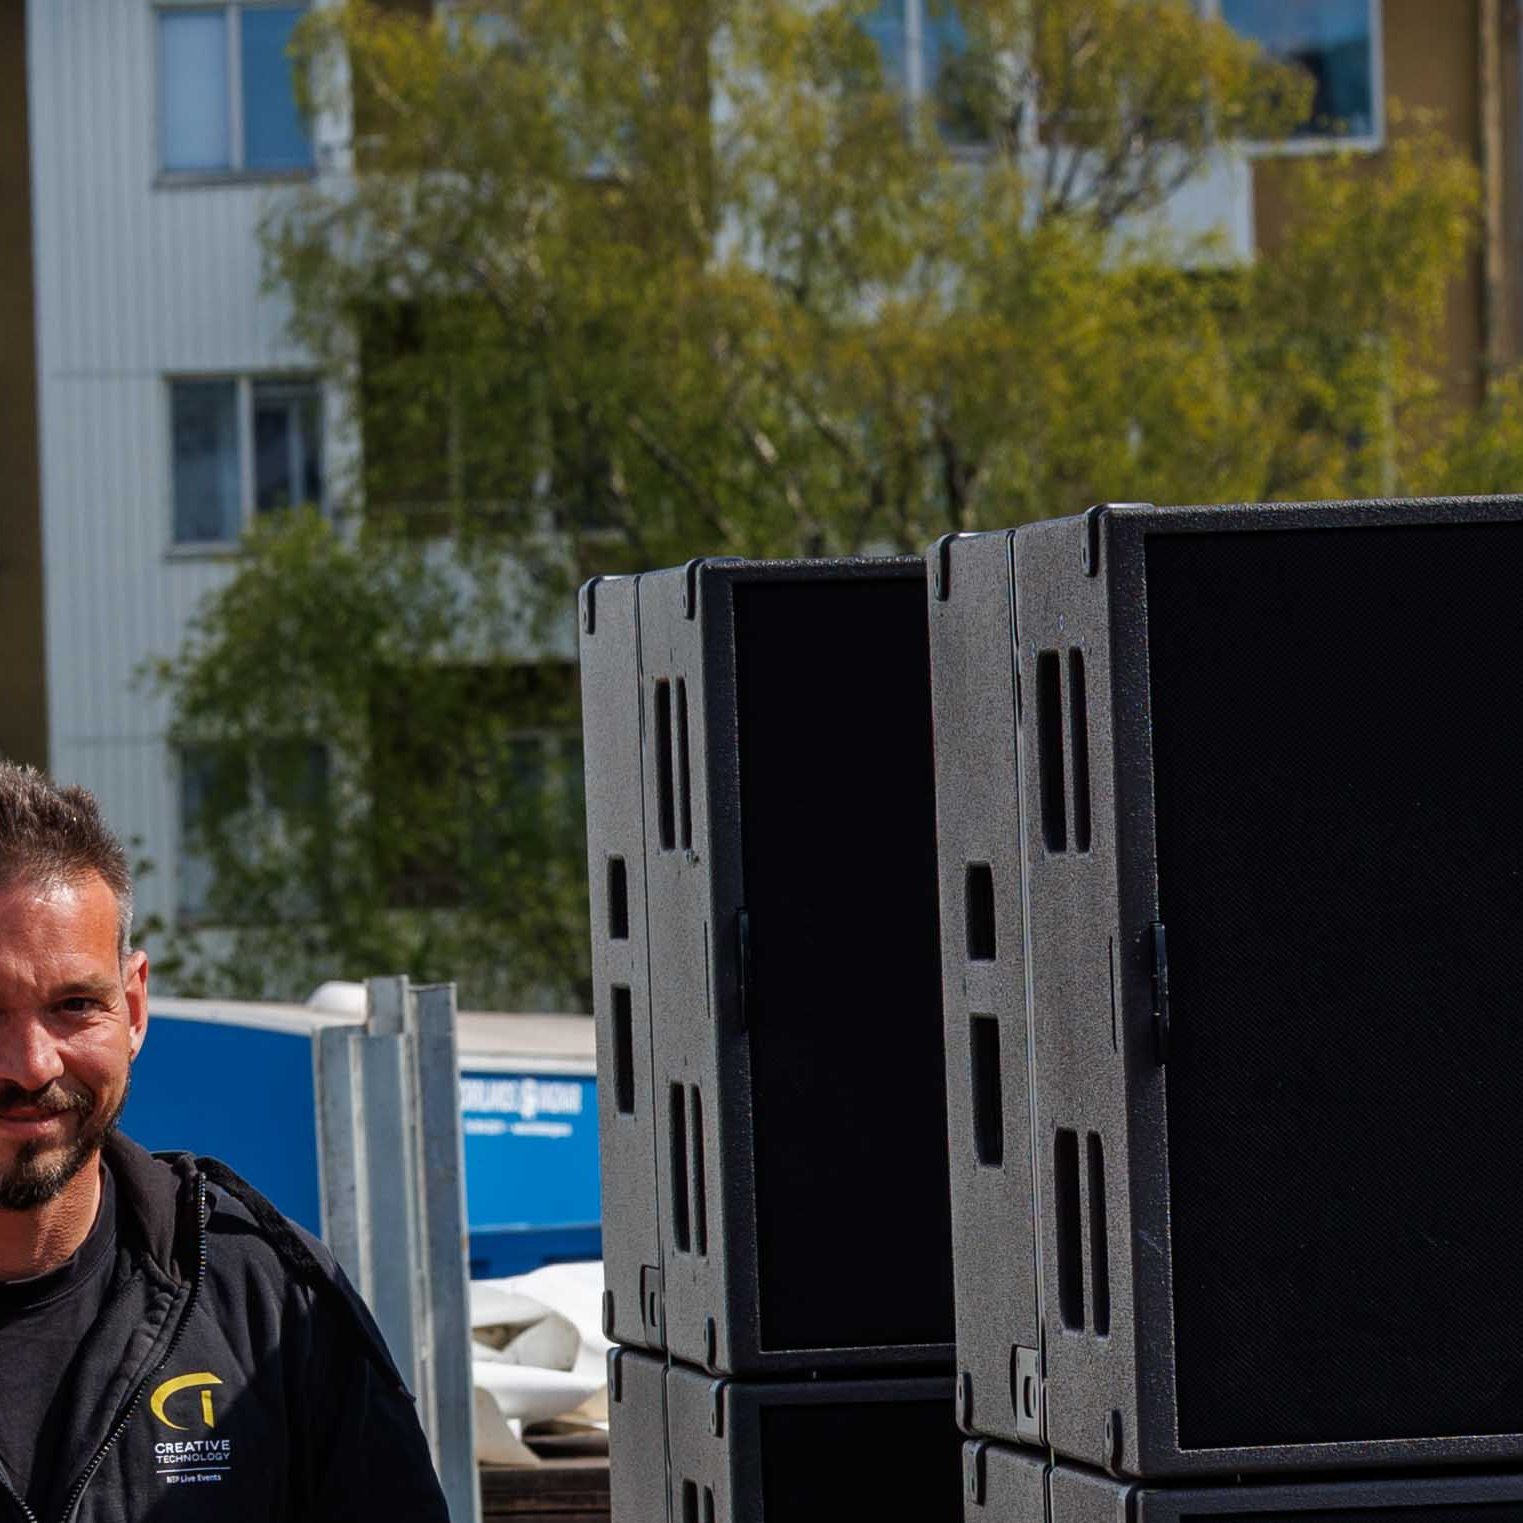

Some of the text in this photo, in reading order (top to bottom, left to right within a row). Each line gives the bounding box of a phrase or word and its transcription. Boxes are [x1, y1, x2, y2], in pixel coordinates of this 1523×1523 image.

[155, 1440, 231, 1454] CREATIVE
[156, 1452, 230, 1464] TECHNOLOGY
[180, 1474, 196, 1483] Live
[197, 1473, 222, 1482] Events
